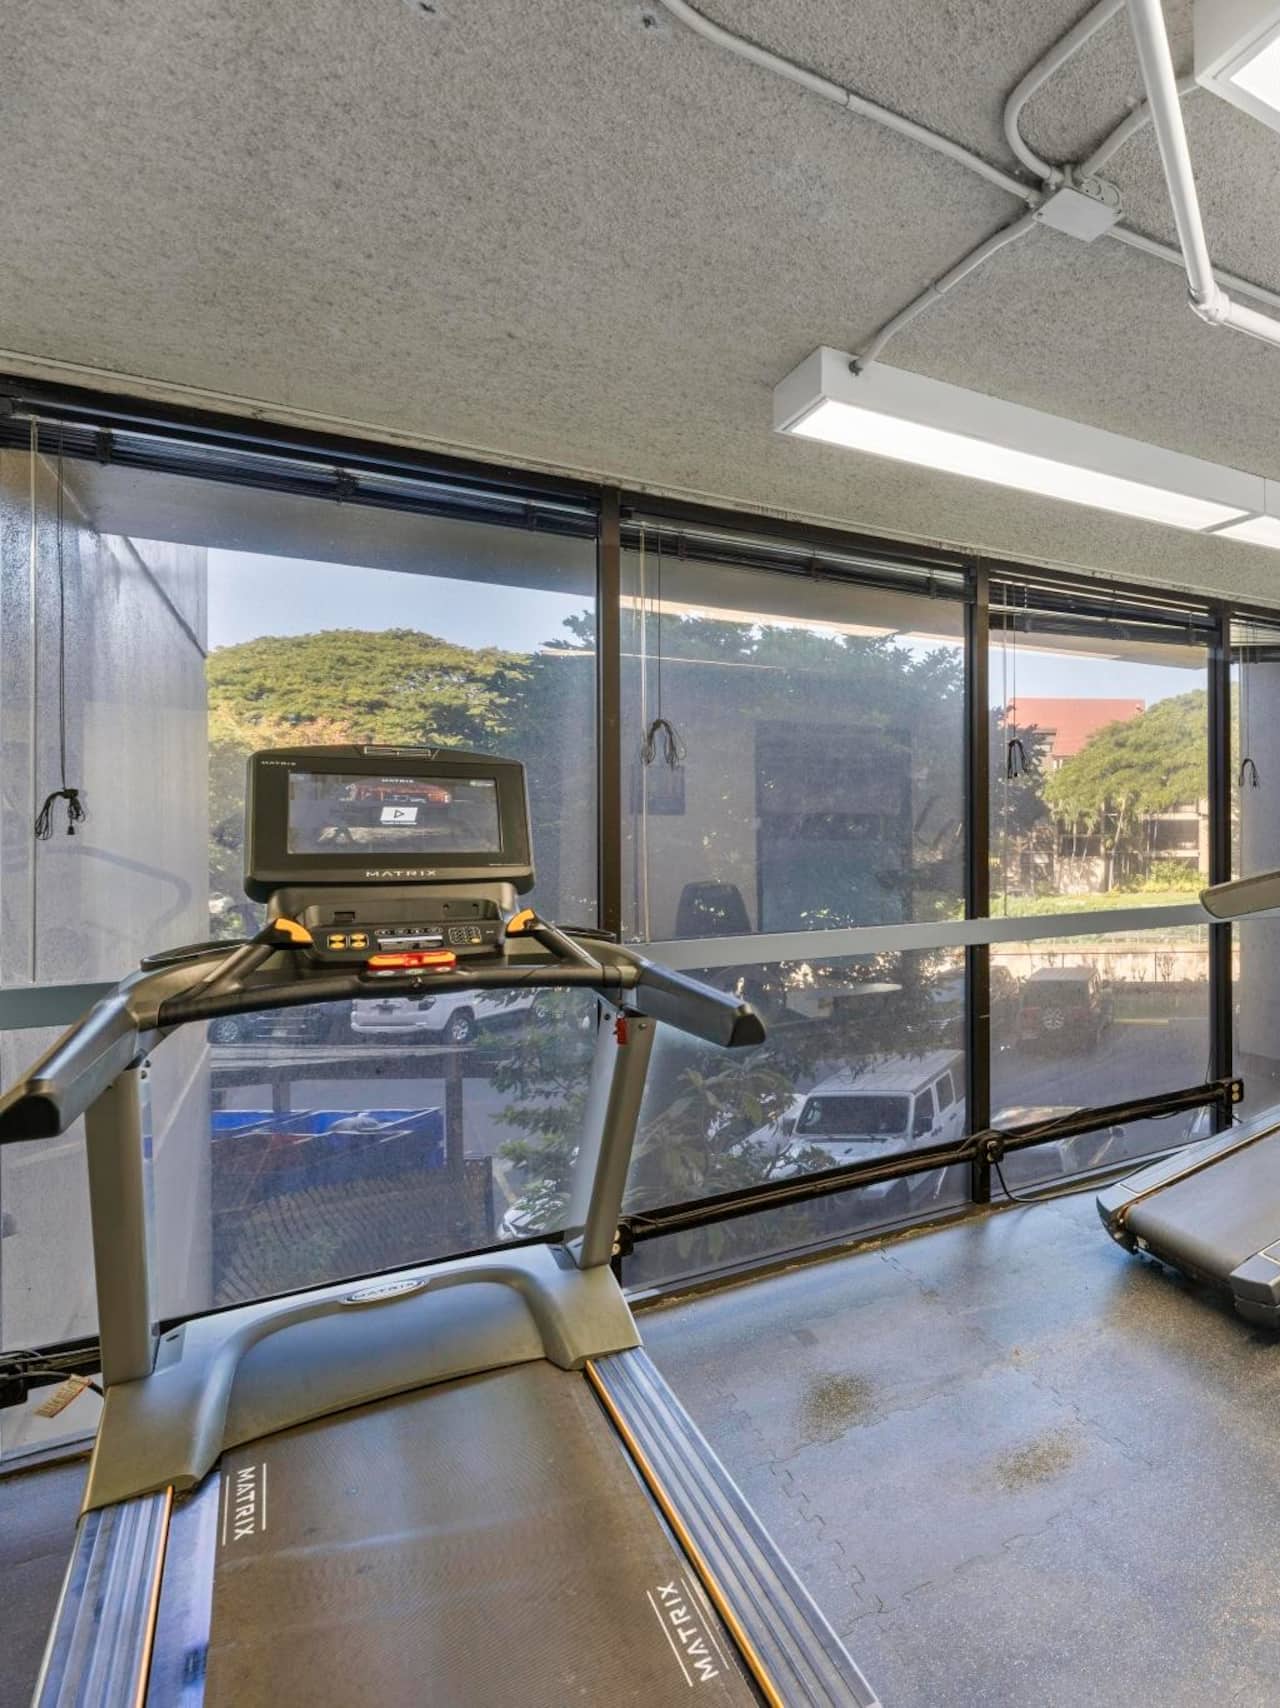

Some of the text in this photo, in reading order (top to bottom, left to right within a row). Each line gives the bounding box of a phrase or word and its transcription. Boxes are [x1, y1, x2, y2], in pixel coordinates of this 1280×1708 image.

[365, 870, 437, 878] MATRIX
[233, 1466, 256, 1541] MATRIX
[656, 1581, 720, 1682] MATRIX
